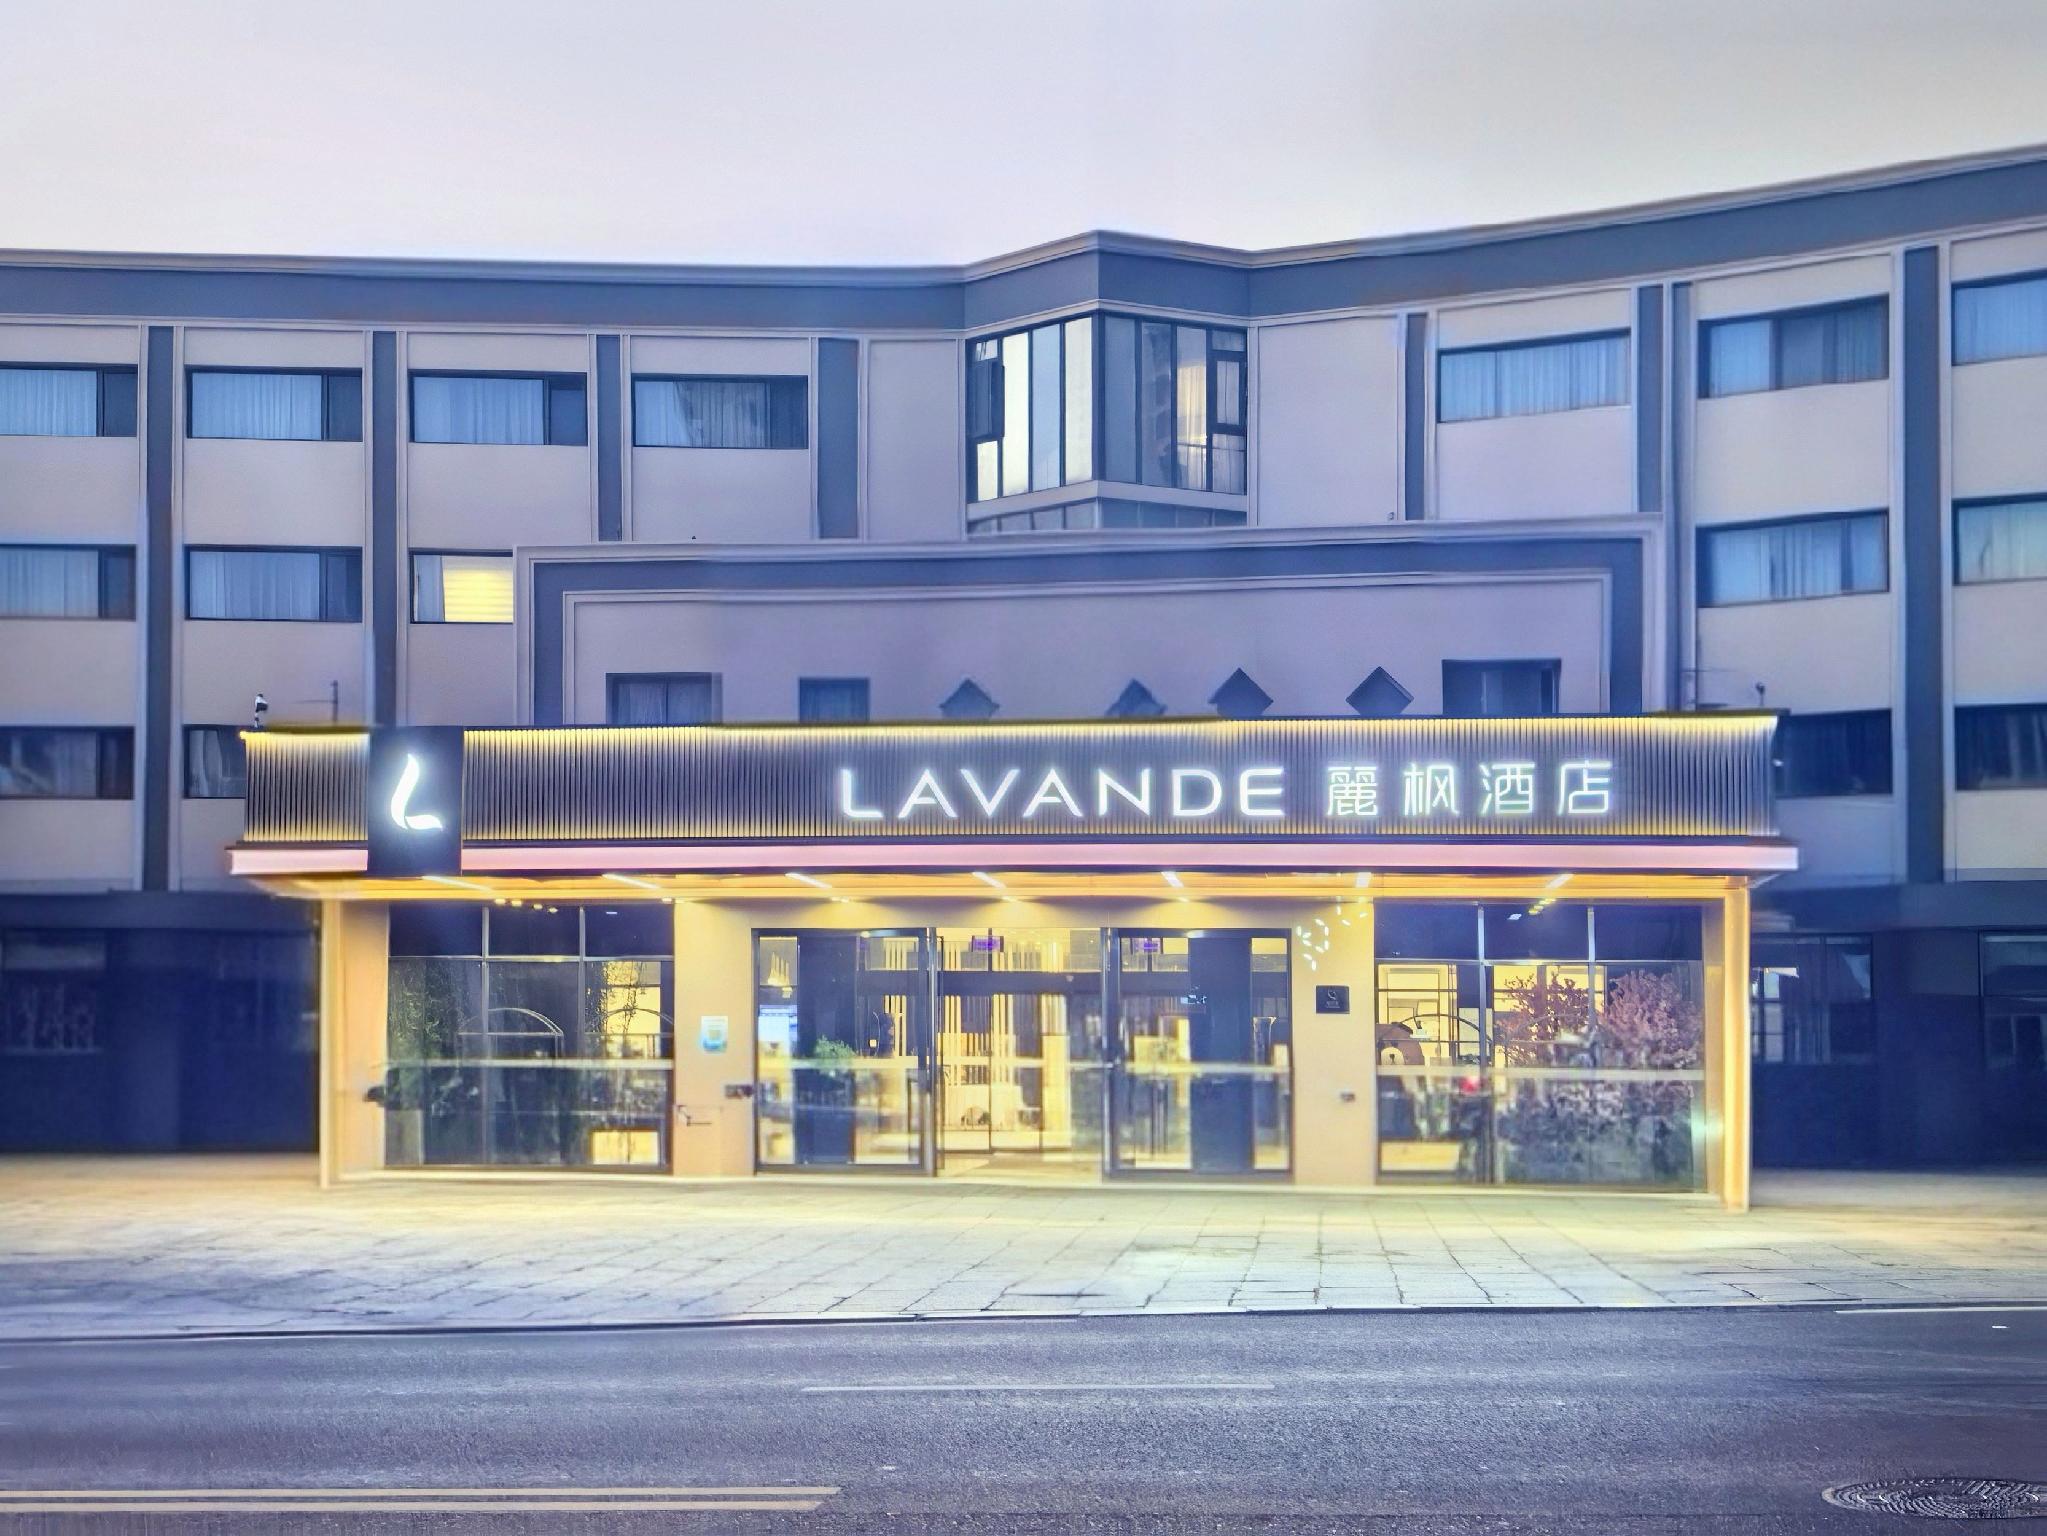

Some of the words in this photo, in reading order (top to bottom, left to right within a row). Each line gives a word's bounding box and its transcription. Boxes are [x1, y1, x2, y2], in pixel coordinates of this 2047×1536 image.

[839, 766, 1286, 819] LAVANDE
[1326, 760, 1613, 817] 麗枫酒店
